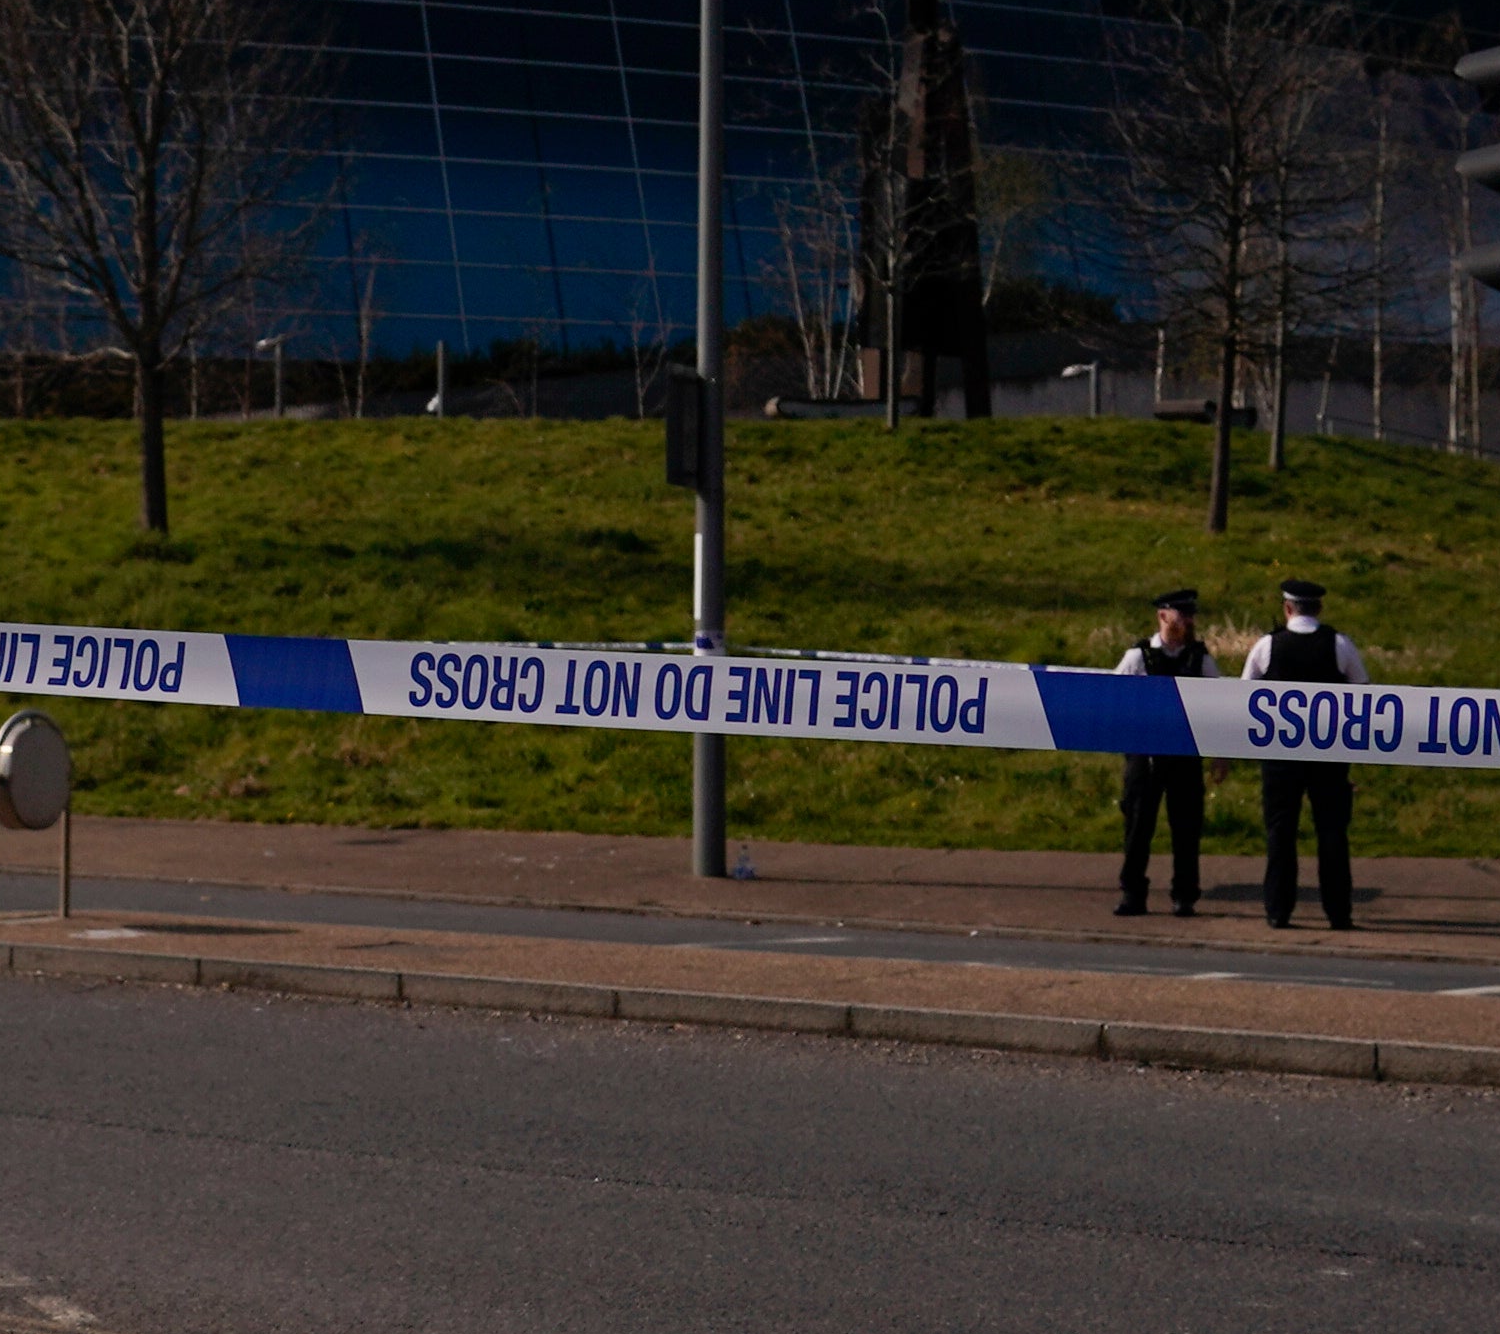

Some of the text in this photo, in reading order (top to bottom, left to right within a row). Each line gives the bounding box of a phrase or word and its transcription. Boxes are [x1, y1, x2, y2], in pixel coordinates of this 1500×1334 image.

[47, 634, 186, 693] POLICE
[409, 651, 989, 734] POLICE LINE DO NOT CROSS
[1247, 688, 1403, 754] CROSS
